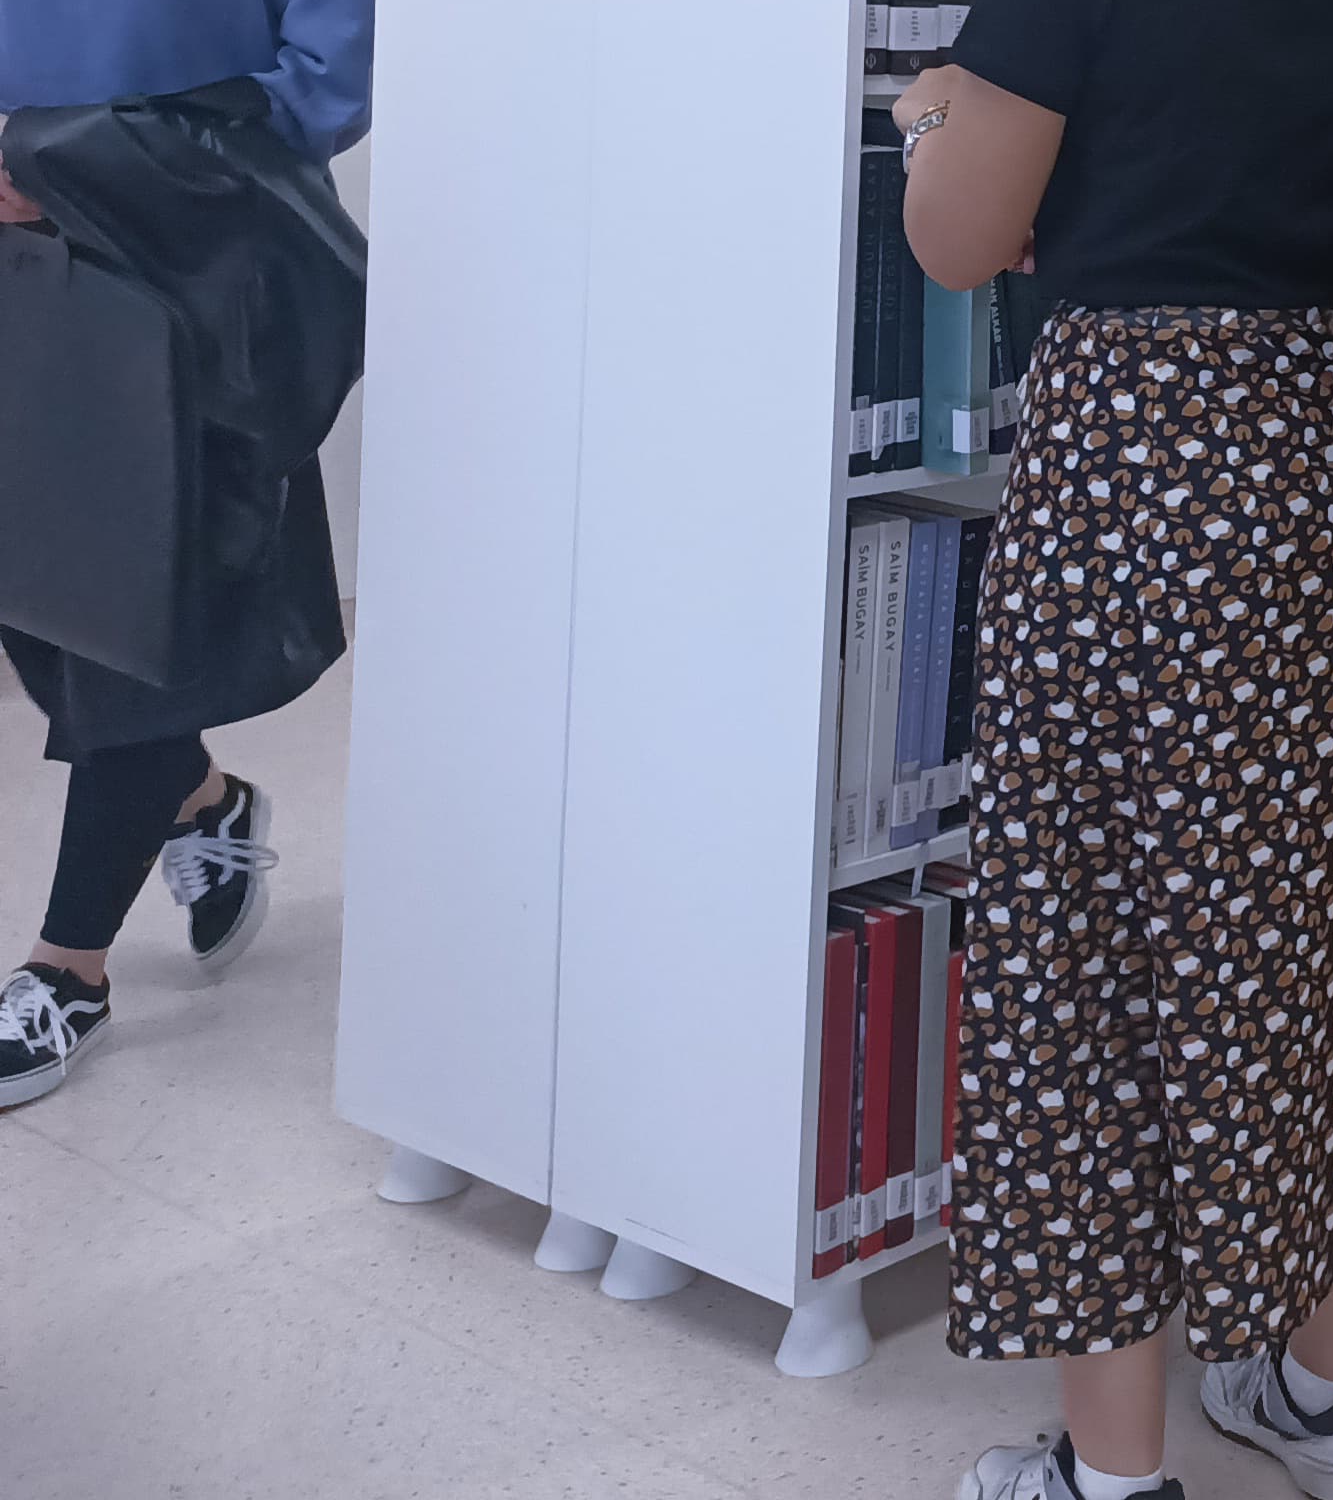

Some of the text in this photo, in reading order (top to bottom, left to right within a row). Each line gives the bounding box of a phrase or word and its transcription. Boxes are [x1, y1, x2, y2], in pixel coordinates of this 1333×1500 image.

[857, 544, 870, 584] SAİM
[888, 540, 902, 584] SAİM
[854, 587, 868, 640] BUGAY
[885, 592, 899, 651] BUGAY
